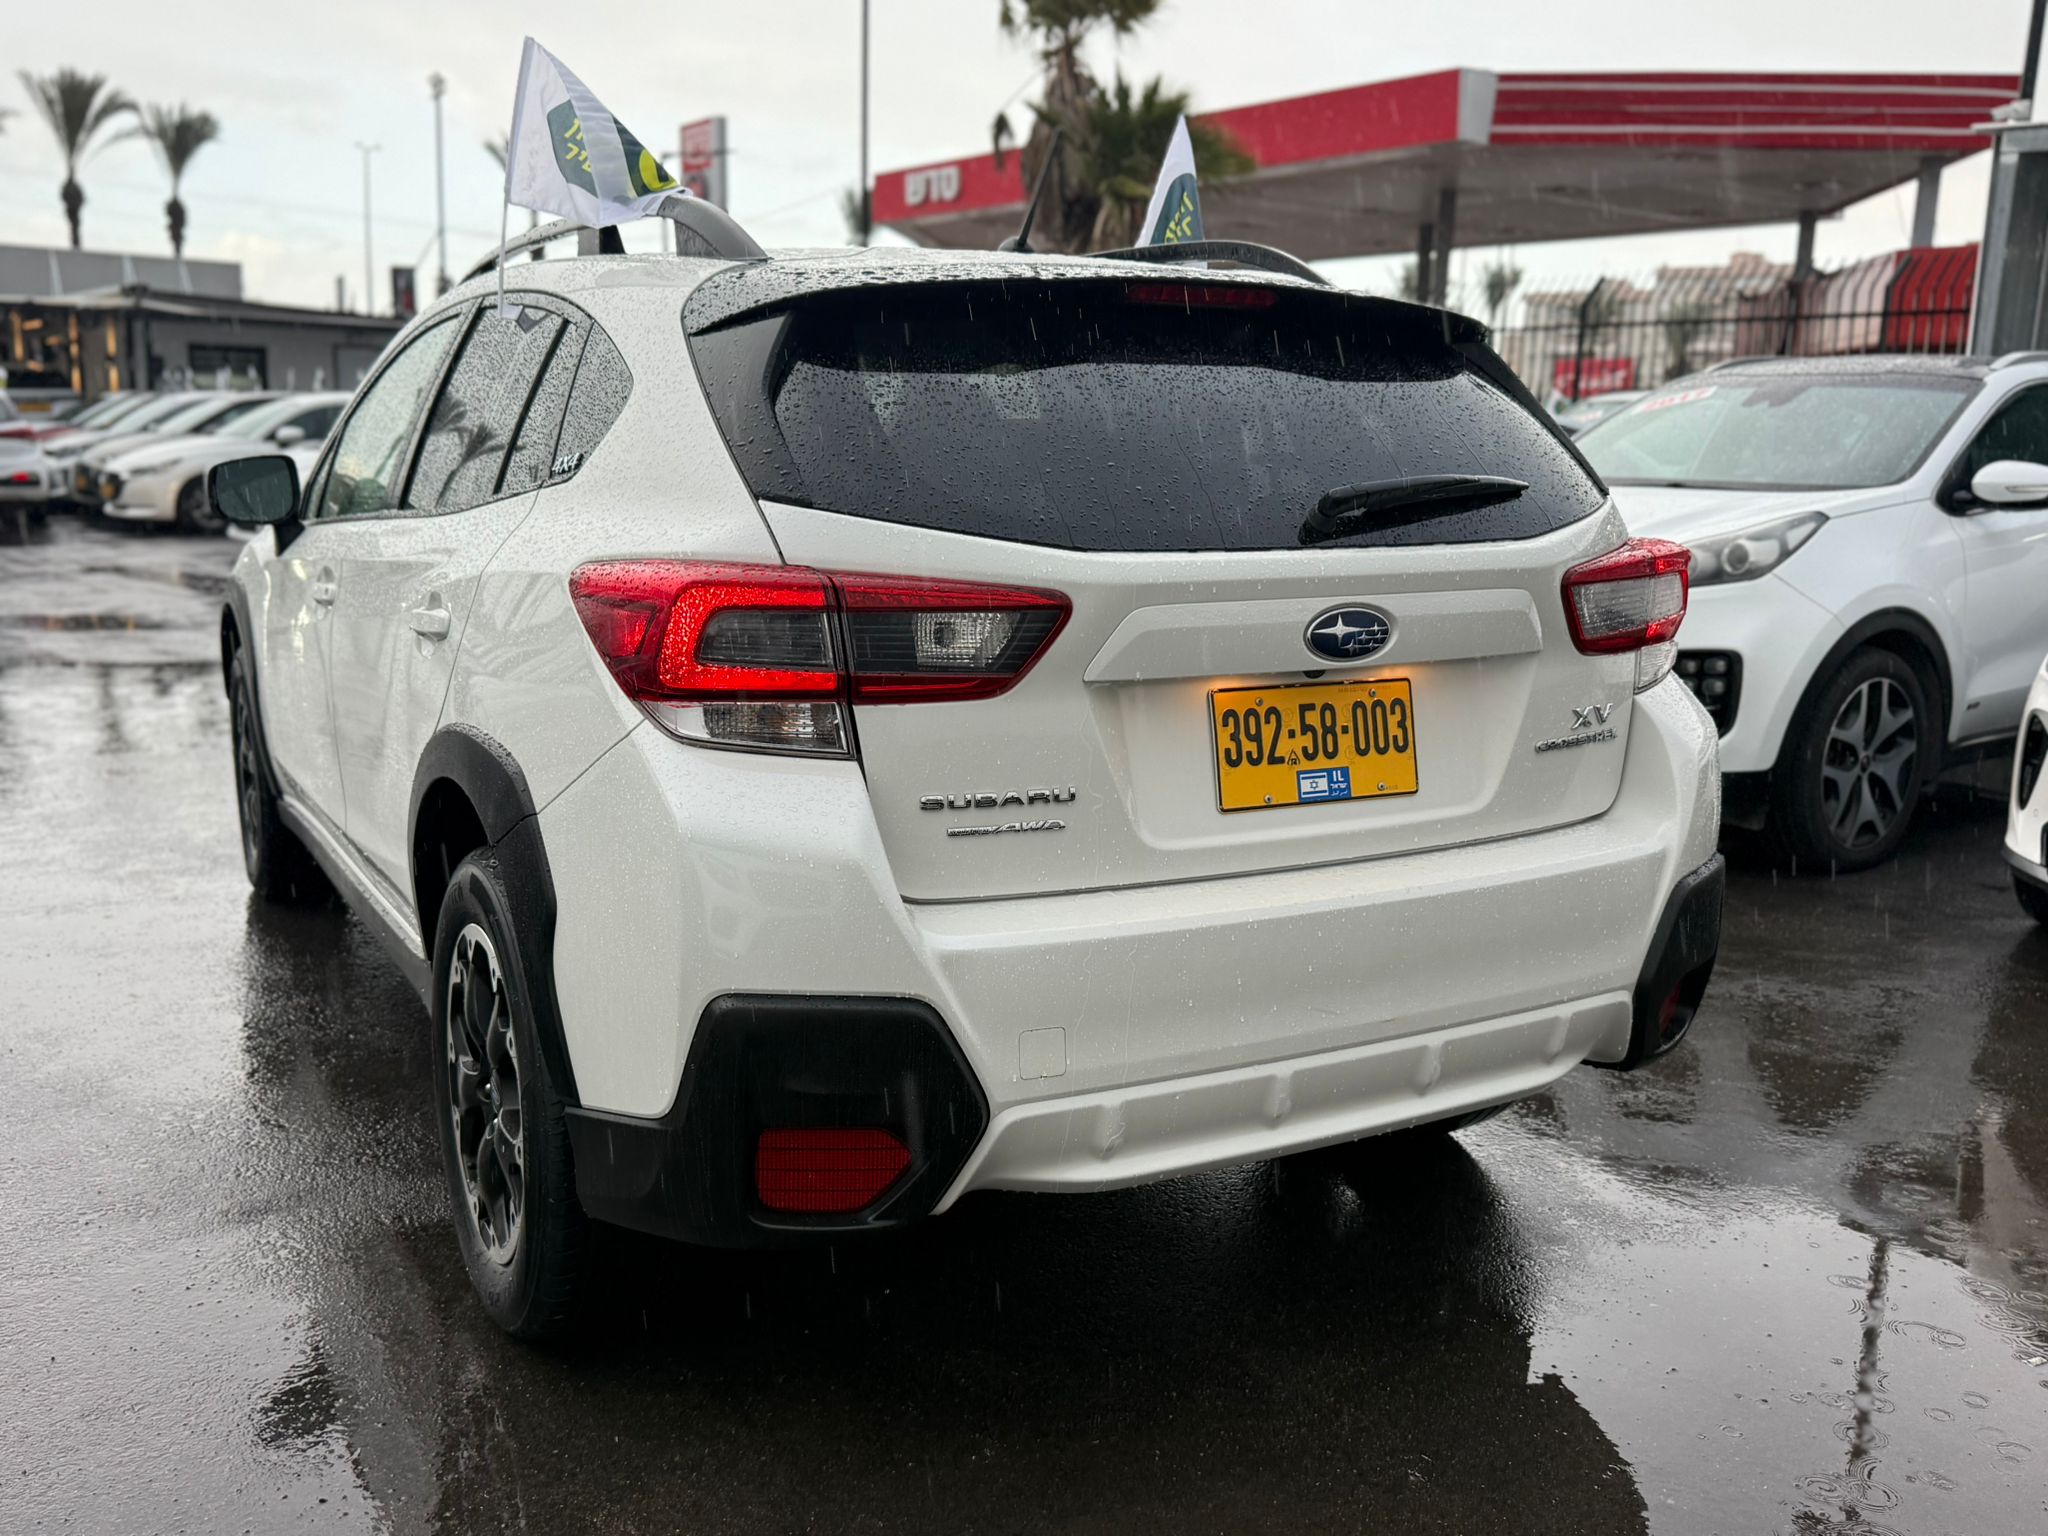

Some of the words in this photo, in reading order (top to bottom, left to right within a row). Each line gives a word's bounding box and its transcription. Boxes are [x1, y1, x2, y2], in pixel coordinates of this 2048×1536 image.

[1570, 702, 1614, 730] XV
[1332, 770, 1344, 782] IL
[919, 785, 1076, 811] SUBARU
[992, 819, 1066, 834] AWD
